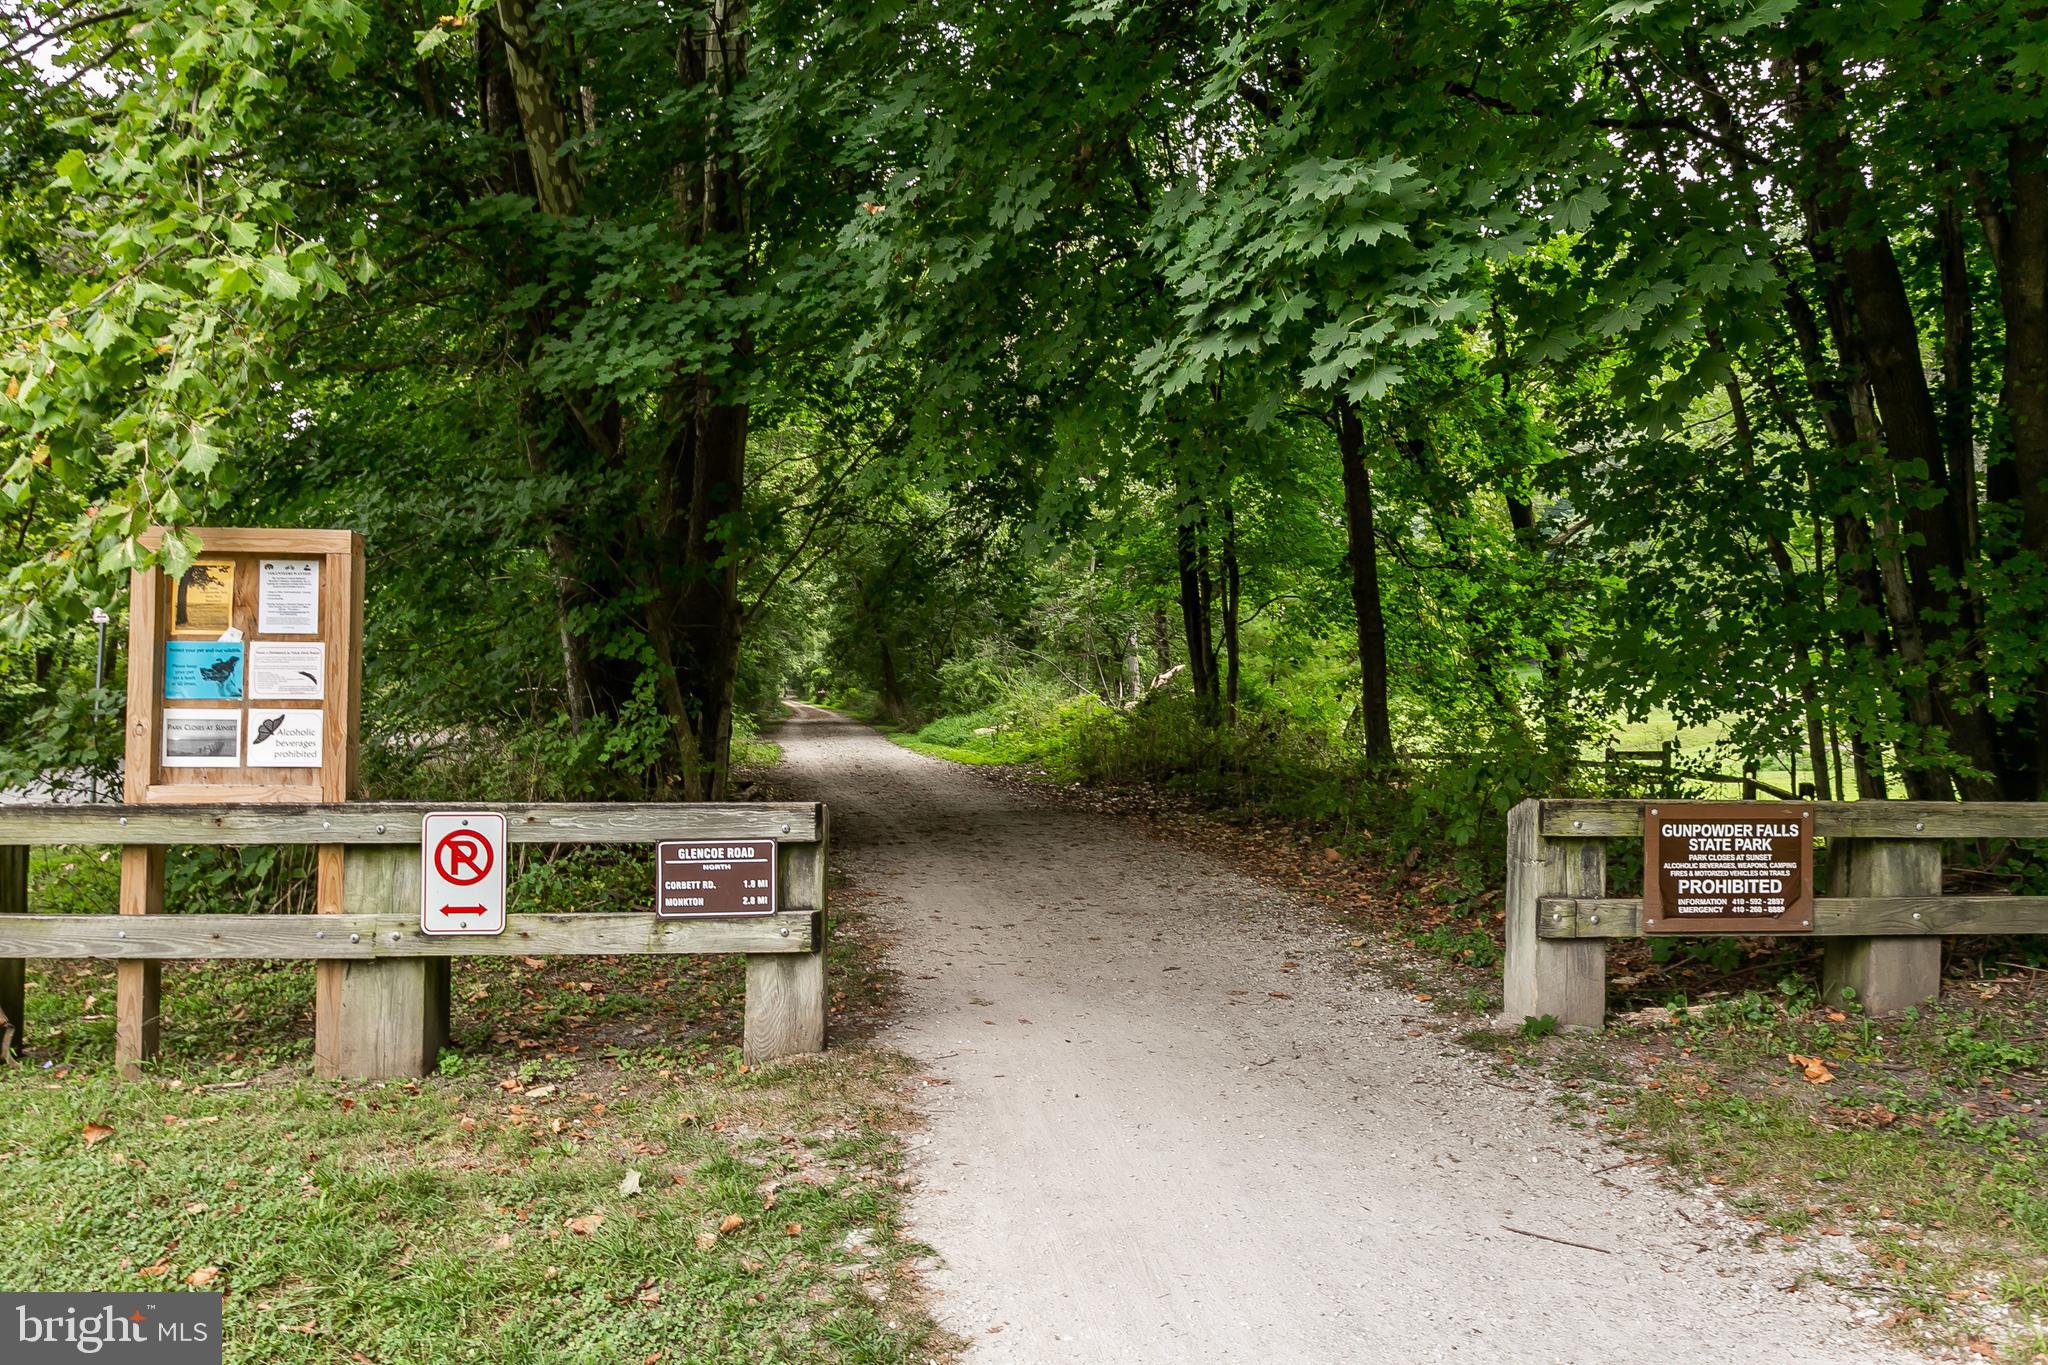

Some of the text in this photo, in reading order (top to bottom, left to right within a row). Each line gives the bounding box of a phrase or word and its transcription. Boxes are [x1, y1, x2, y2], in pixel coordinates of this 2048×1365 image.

[276, 740, 316, 748] beverages
[1662, 824, 1799, 837] GUNPOWDER FALLS
[1689, 838, 1772, 851] STATE PARK
[678, 847, 755, 859] GLENCOE ROAD
[665, 880, 768, 890] CORBETT RD. 1.8 MI
[1678, 879, 1782, 894] PROHIBITED
[665, 897, 704, 907] MONKTON
[757, 896, 768, 905] MI
